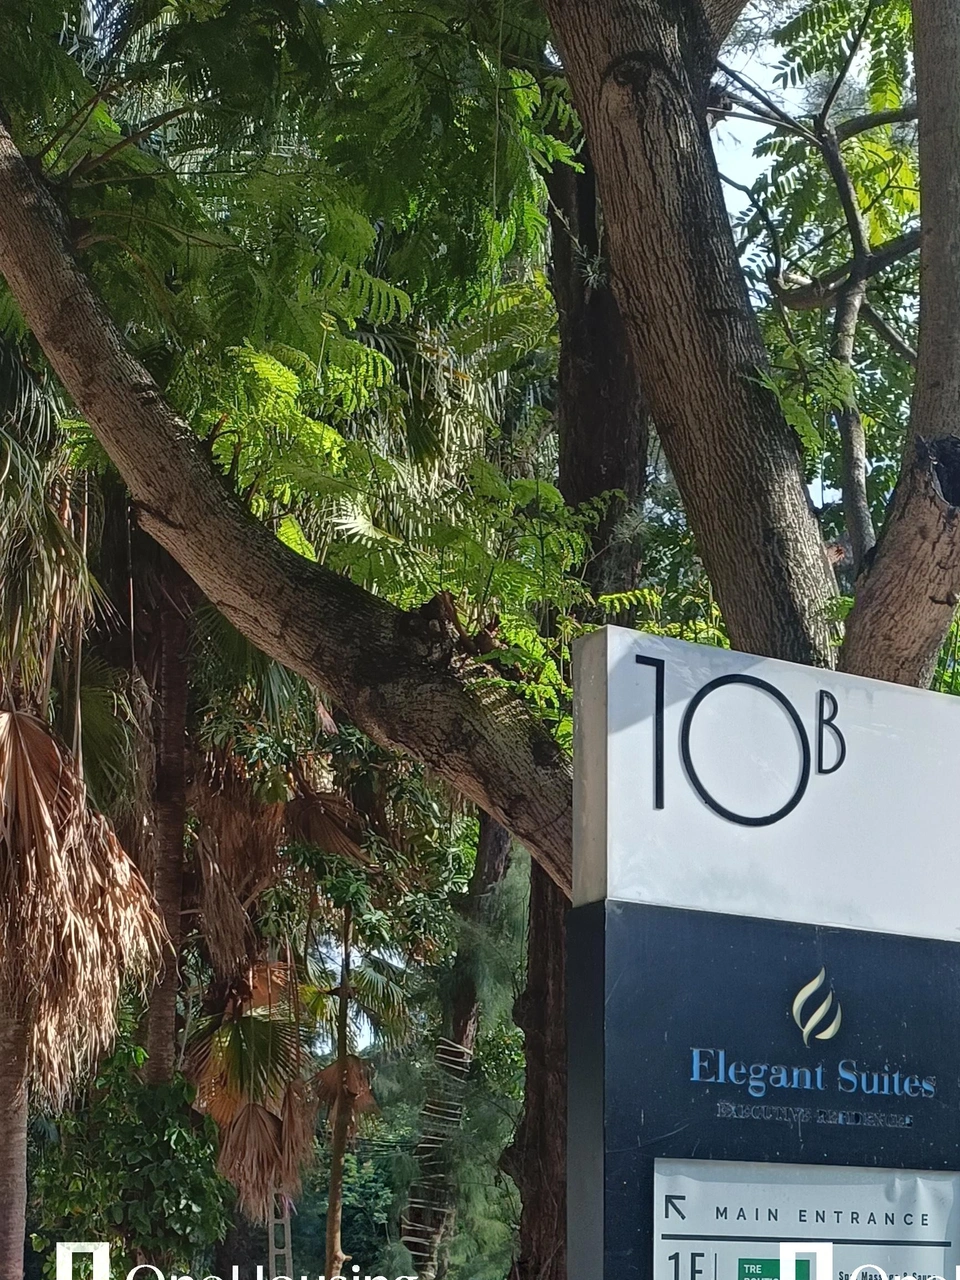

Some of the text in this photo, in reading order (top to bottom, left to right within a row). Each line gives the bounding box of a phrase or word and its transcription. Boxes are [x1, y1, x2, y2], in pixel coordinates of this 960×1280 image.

[690, 1047, 937, 1099] Elegant Suites
[715, 1206, 929, 1226] MAIN ENTRANCE
[743, 1264, 762, 1274] TRE
